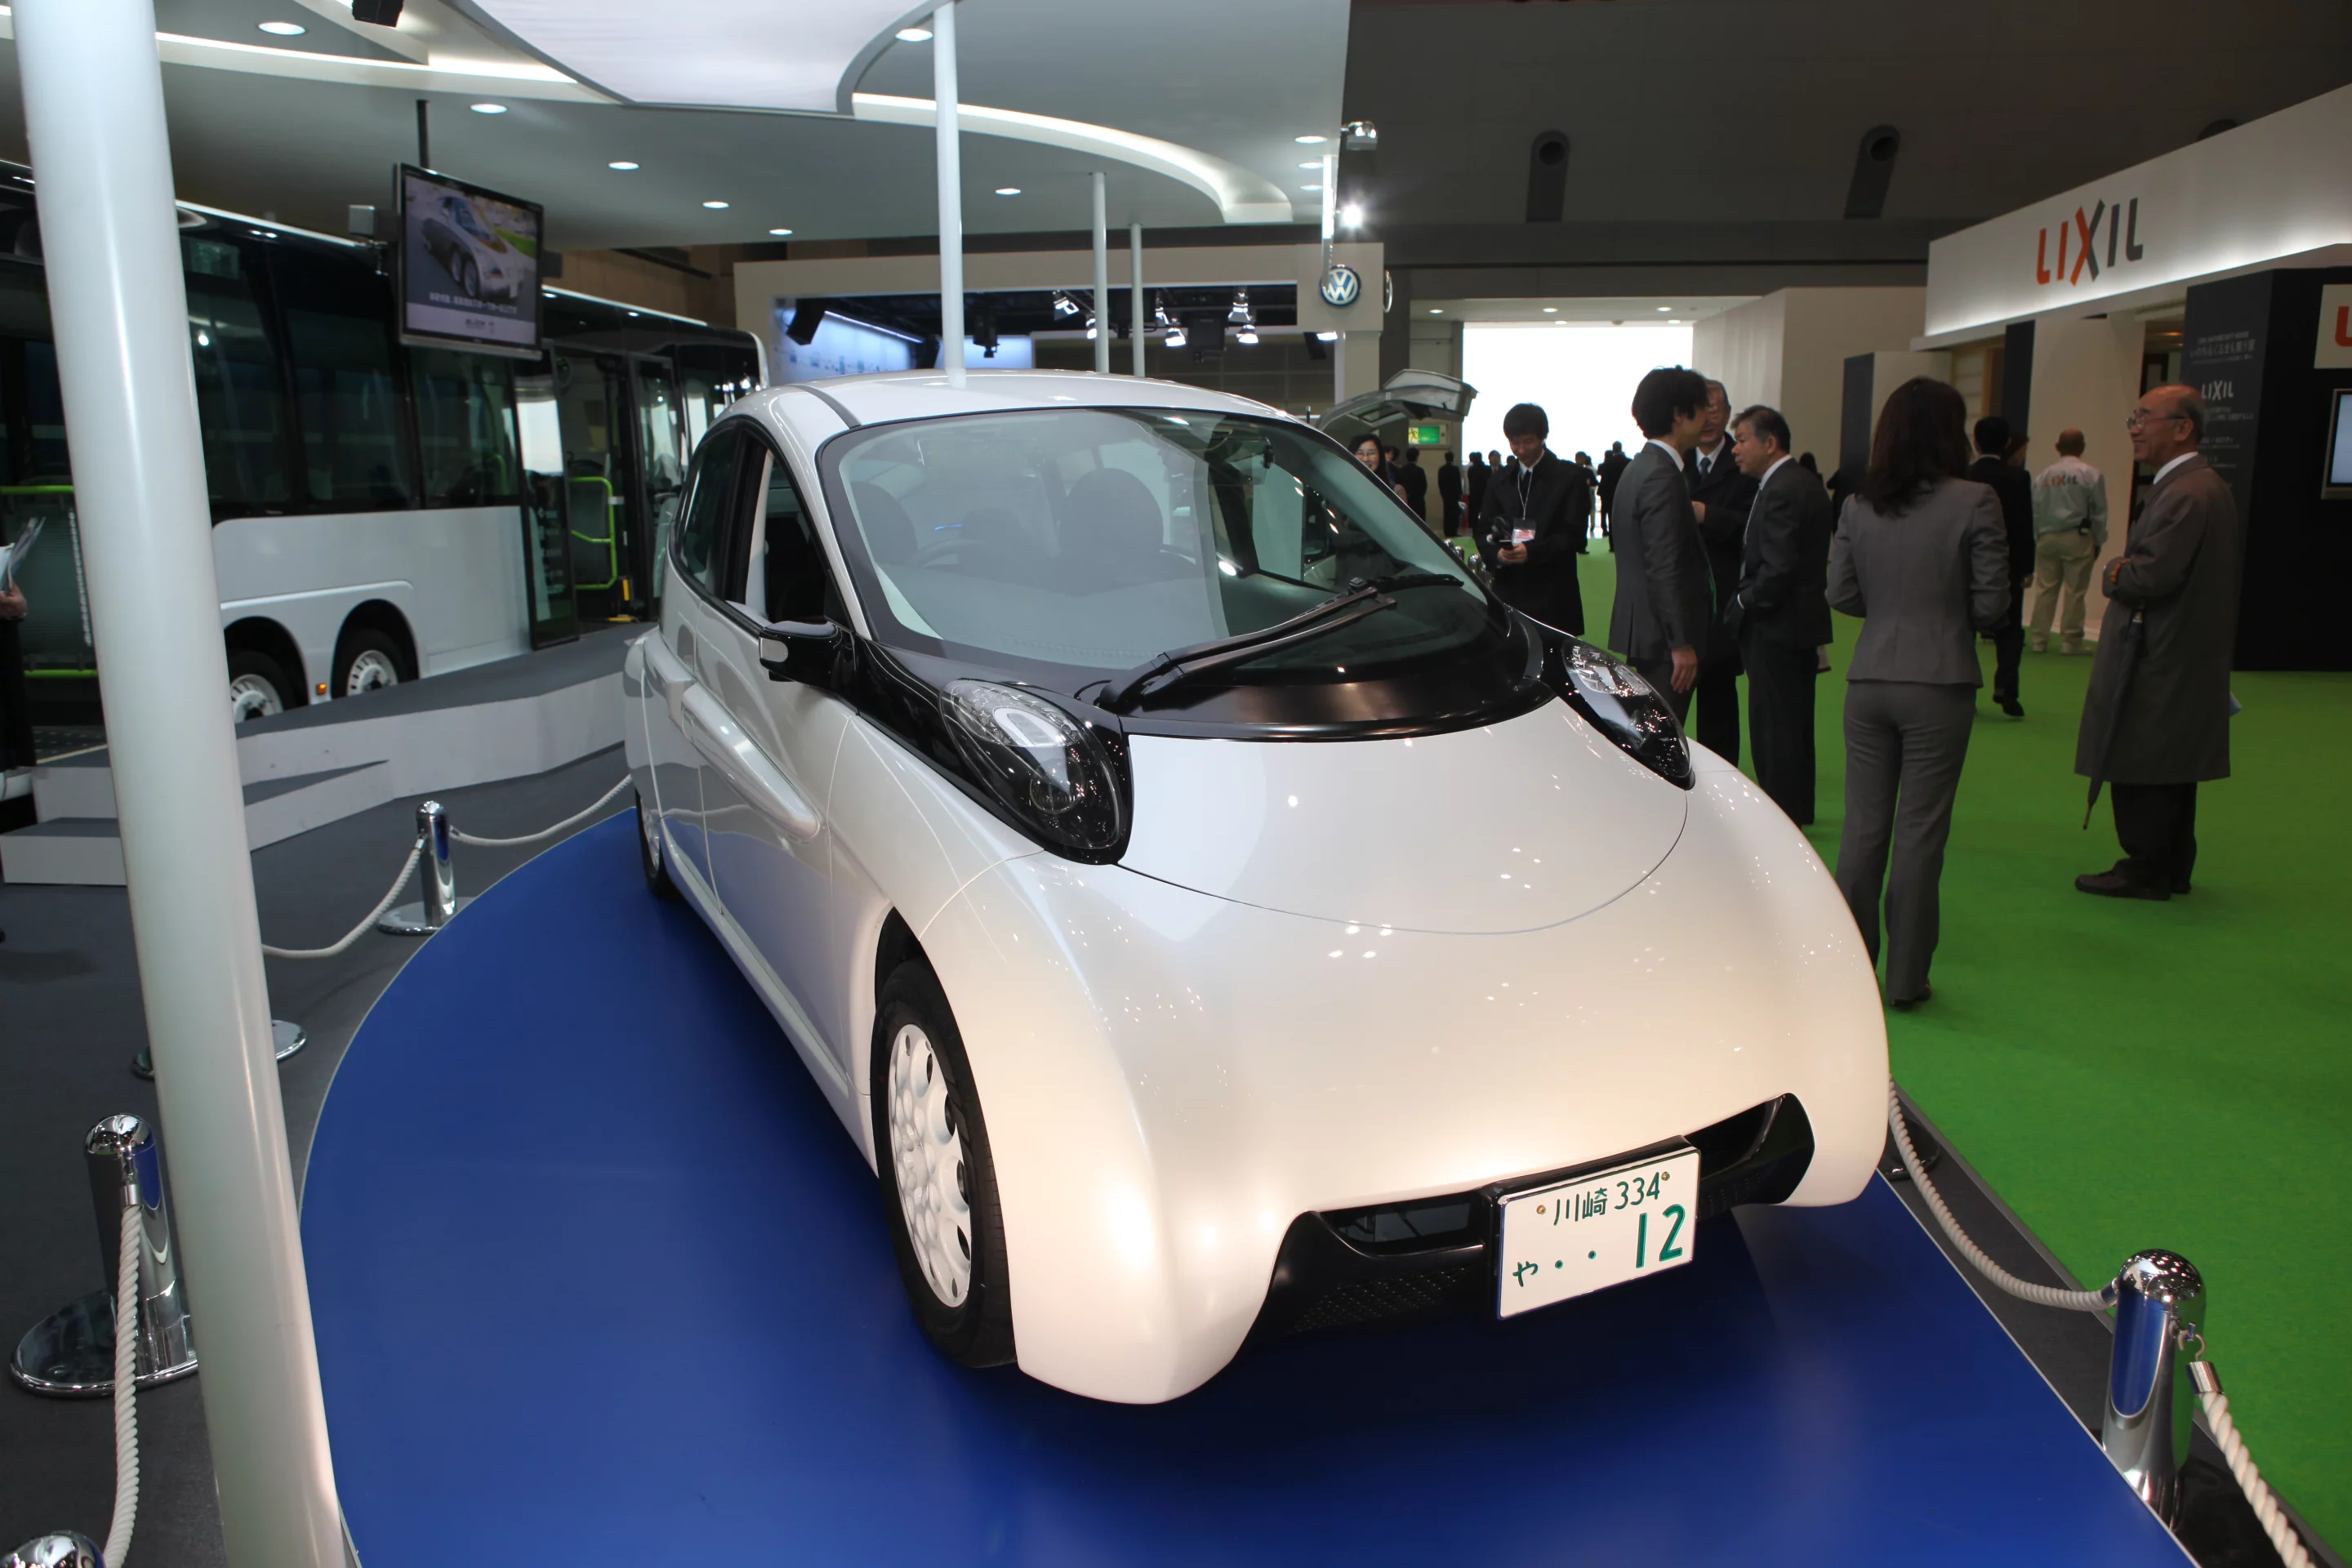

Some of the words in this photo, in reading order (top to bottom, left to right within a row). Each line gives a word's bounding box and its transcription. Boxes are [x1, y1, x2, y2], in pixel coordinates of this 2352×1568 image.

[2036, 197, 2144, 287] LIXIL
[2201, 379, 2234, 401] LIXIL
[1553, 1187, 1608, 1226] 川崎
[1614, 1171, 1660, 1210] 334
[1512, 1261, 1539, 1287] や
[1635, 1203, 1686, 1269] 12
